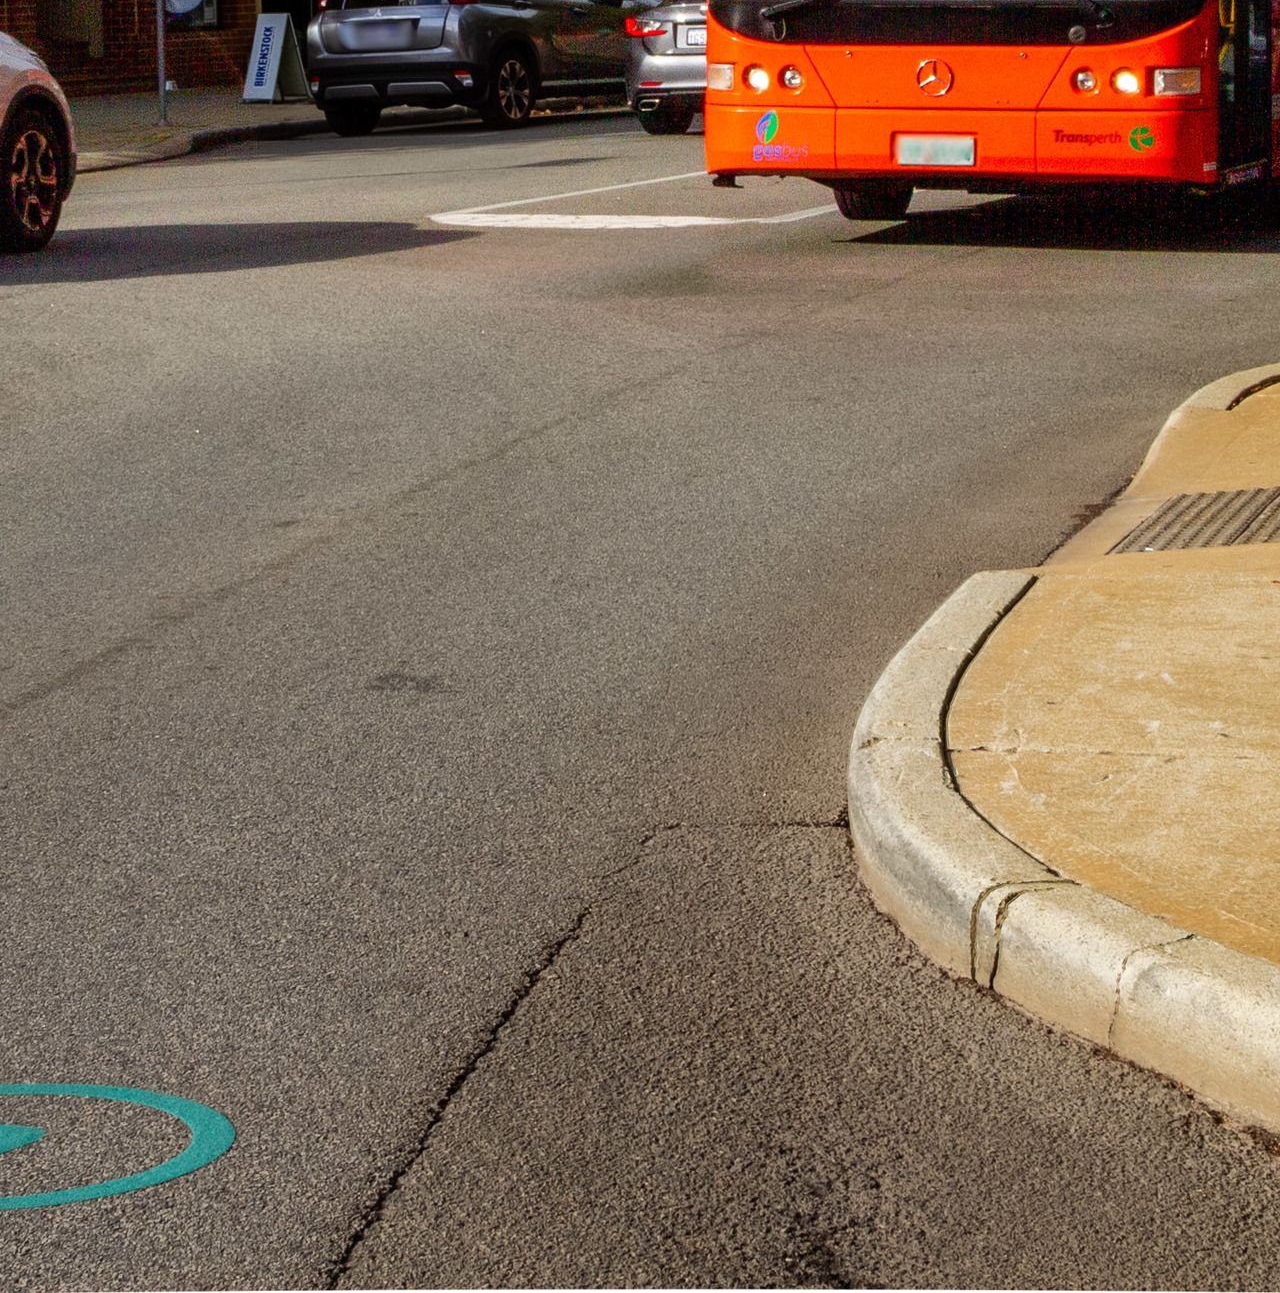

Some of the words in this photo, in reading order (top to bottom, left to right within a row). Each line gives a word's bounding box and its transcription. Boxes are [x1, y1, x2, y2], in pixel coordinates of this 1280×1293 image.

[254, 26, 273, 87] BIRKENSTOCK
[1053, 129, 1122, 146] Transperth
[752, 142, 809, 162] gasbus
